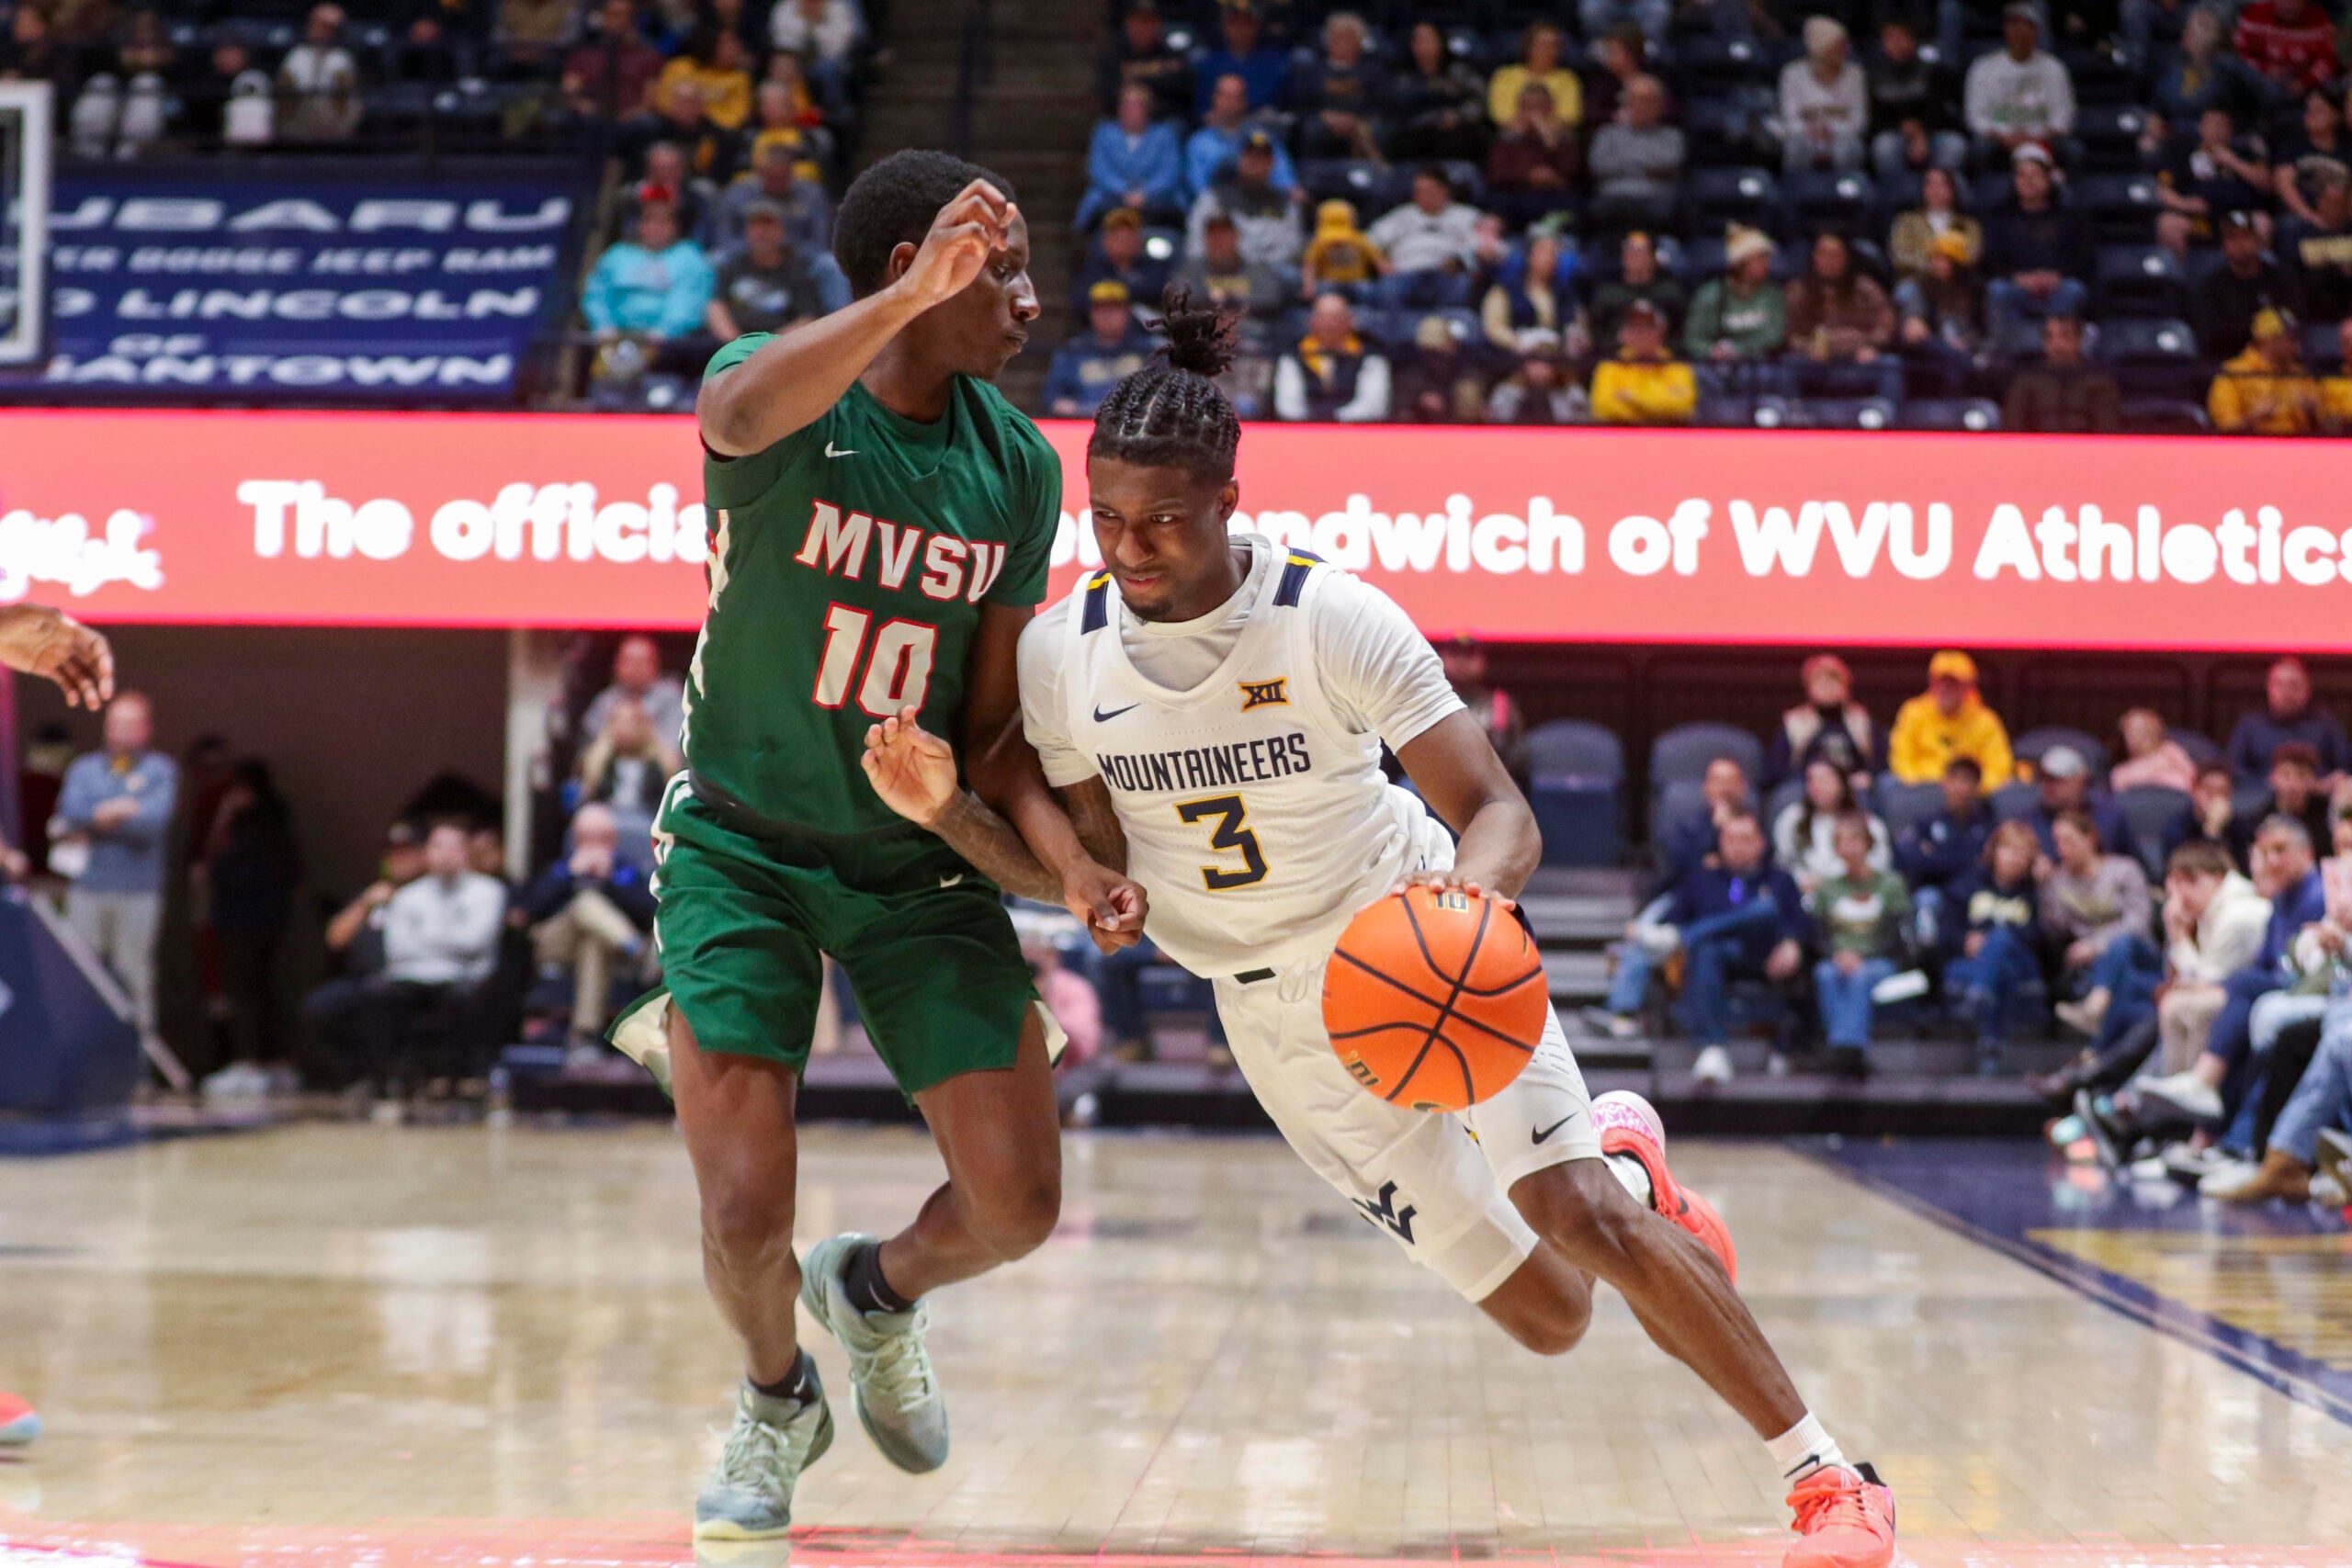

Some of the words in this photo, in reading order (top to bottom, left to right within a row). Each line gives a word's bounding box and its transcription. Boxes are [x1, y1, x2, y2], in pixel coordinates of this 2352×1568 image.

[129, 247, 304, 274] DODGE
[311, 247, 435, 274] JEEP
[441, 245, 557, 273] RAM
[117, 288, 540, 319] LINCOLN
[108, 333, 209, 356] OF
[236, 479, 413, 559] The
[429, 481, 707, 563] officia
[1608, 498, 1711, 576] of
[1728, 500, 1953, 580] WVU
[793, 498, 1007, 605] MVSU
[812, 601, 939, 719] 10
[1096, 732, 1312, 792] MOUNTAINEERS
[1172, 793, 1271, 892] 3
